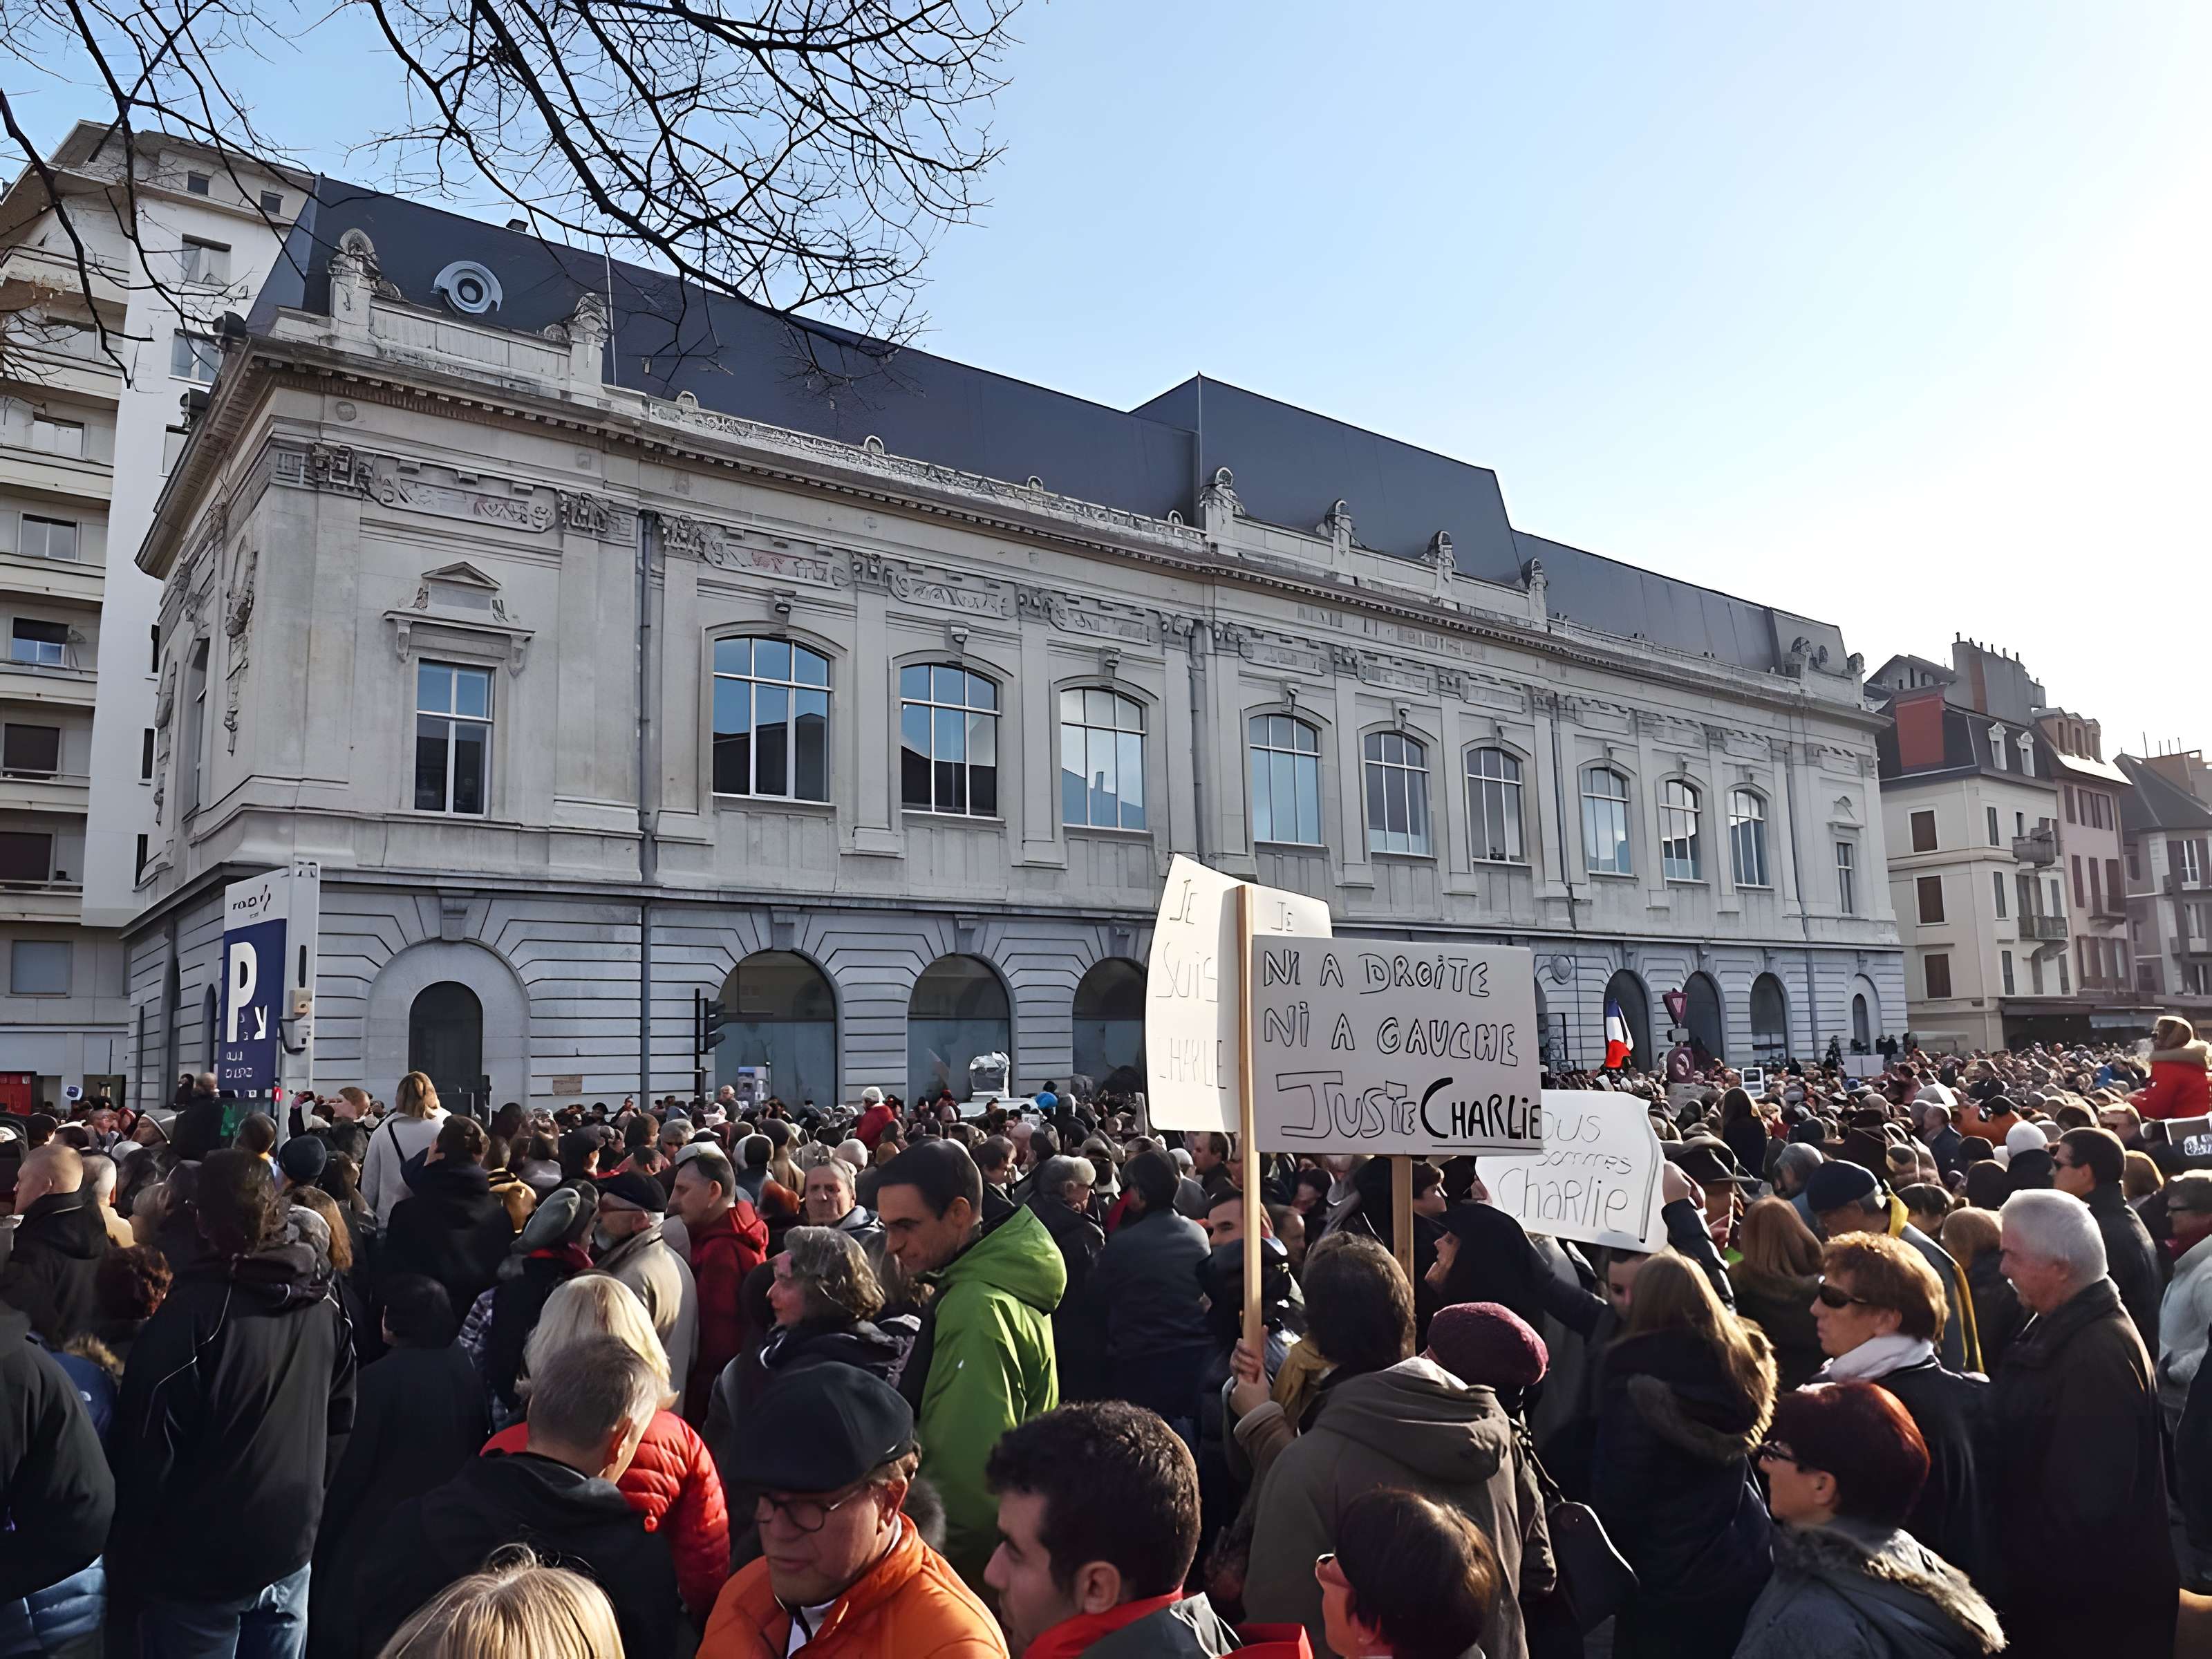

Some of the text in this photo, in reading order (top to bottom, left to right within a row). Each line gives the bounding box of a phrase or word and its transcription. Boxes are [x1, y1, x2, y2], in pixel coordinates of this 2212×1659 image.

[1169, 879, 1199, 925] JE
[1271, 901, 1294, 932] JE
[227, 941, 257, 1042] P
[1320, 953, 1344, 988] A
[1331, 1013, 1356, 1051] A
[1376, 1017, 1519, 1067] GAUCHE
